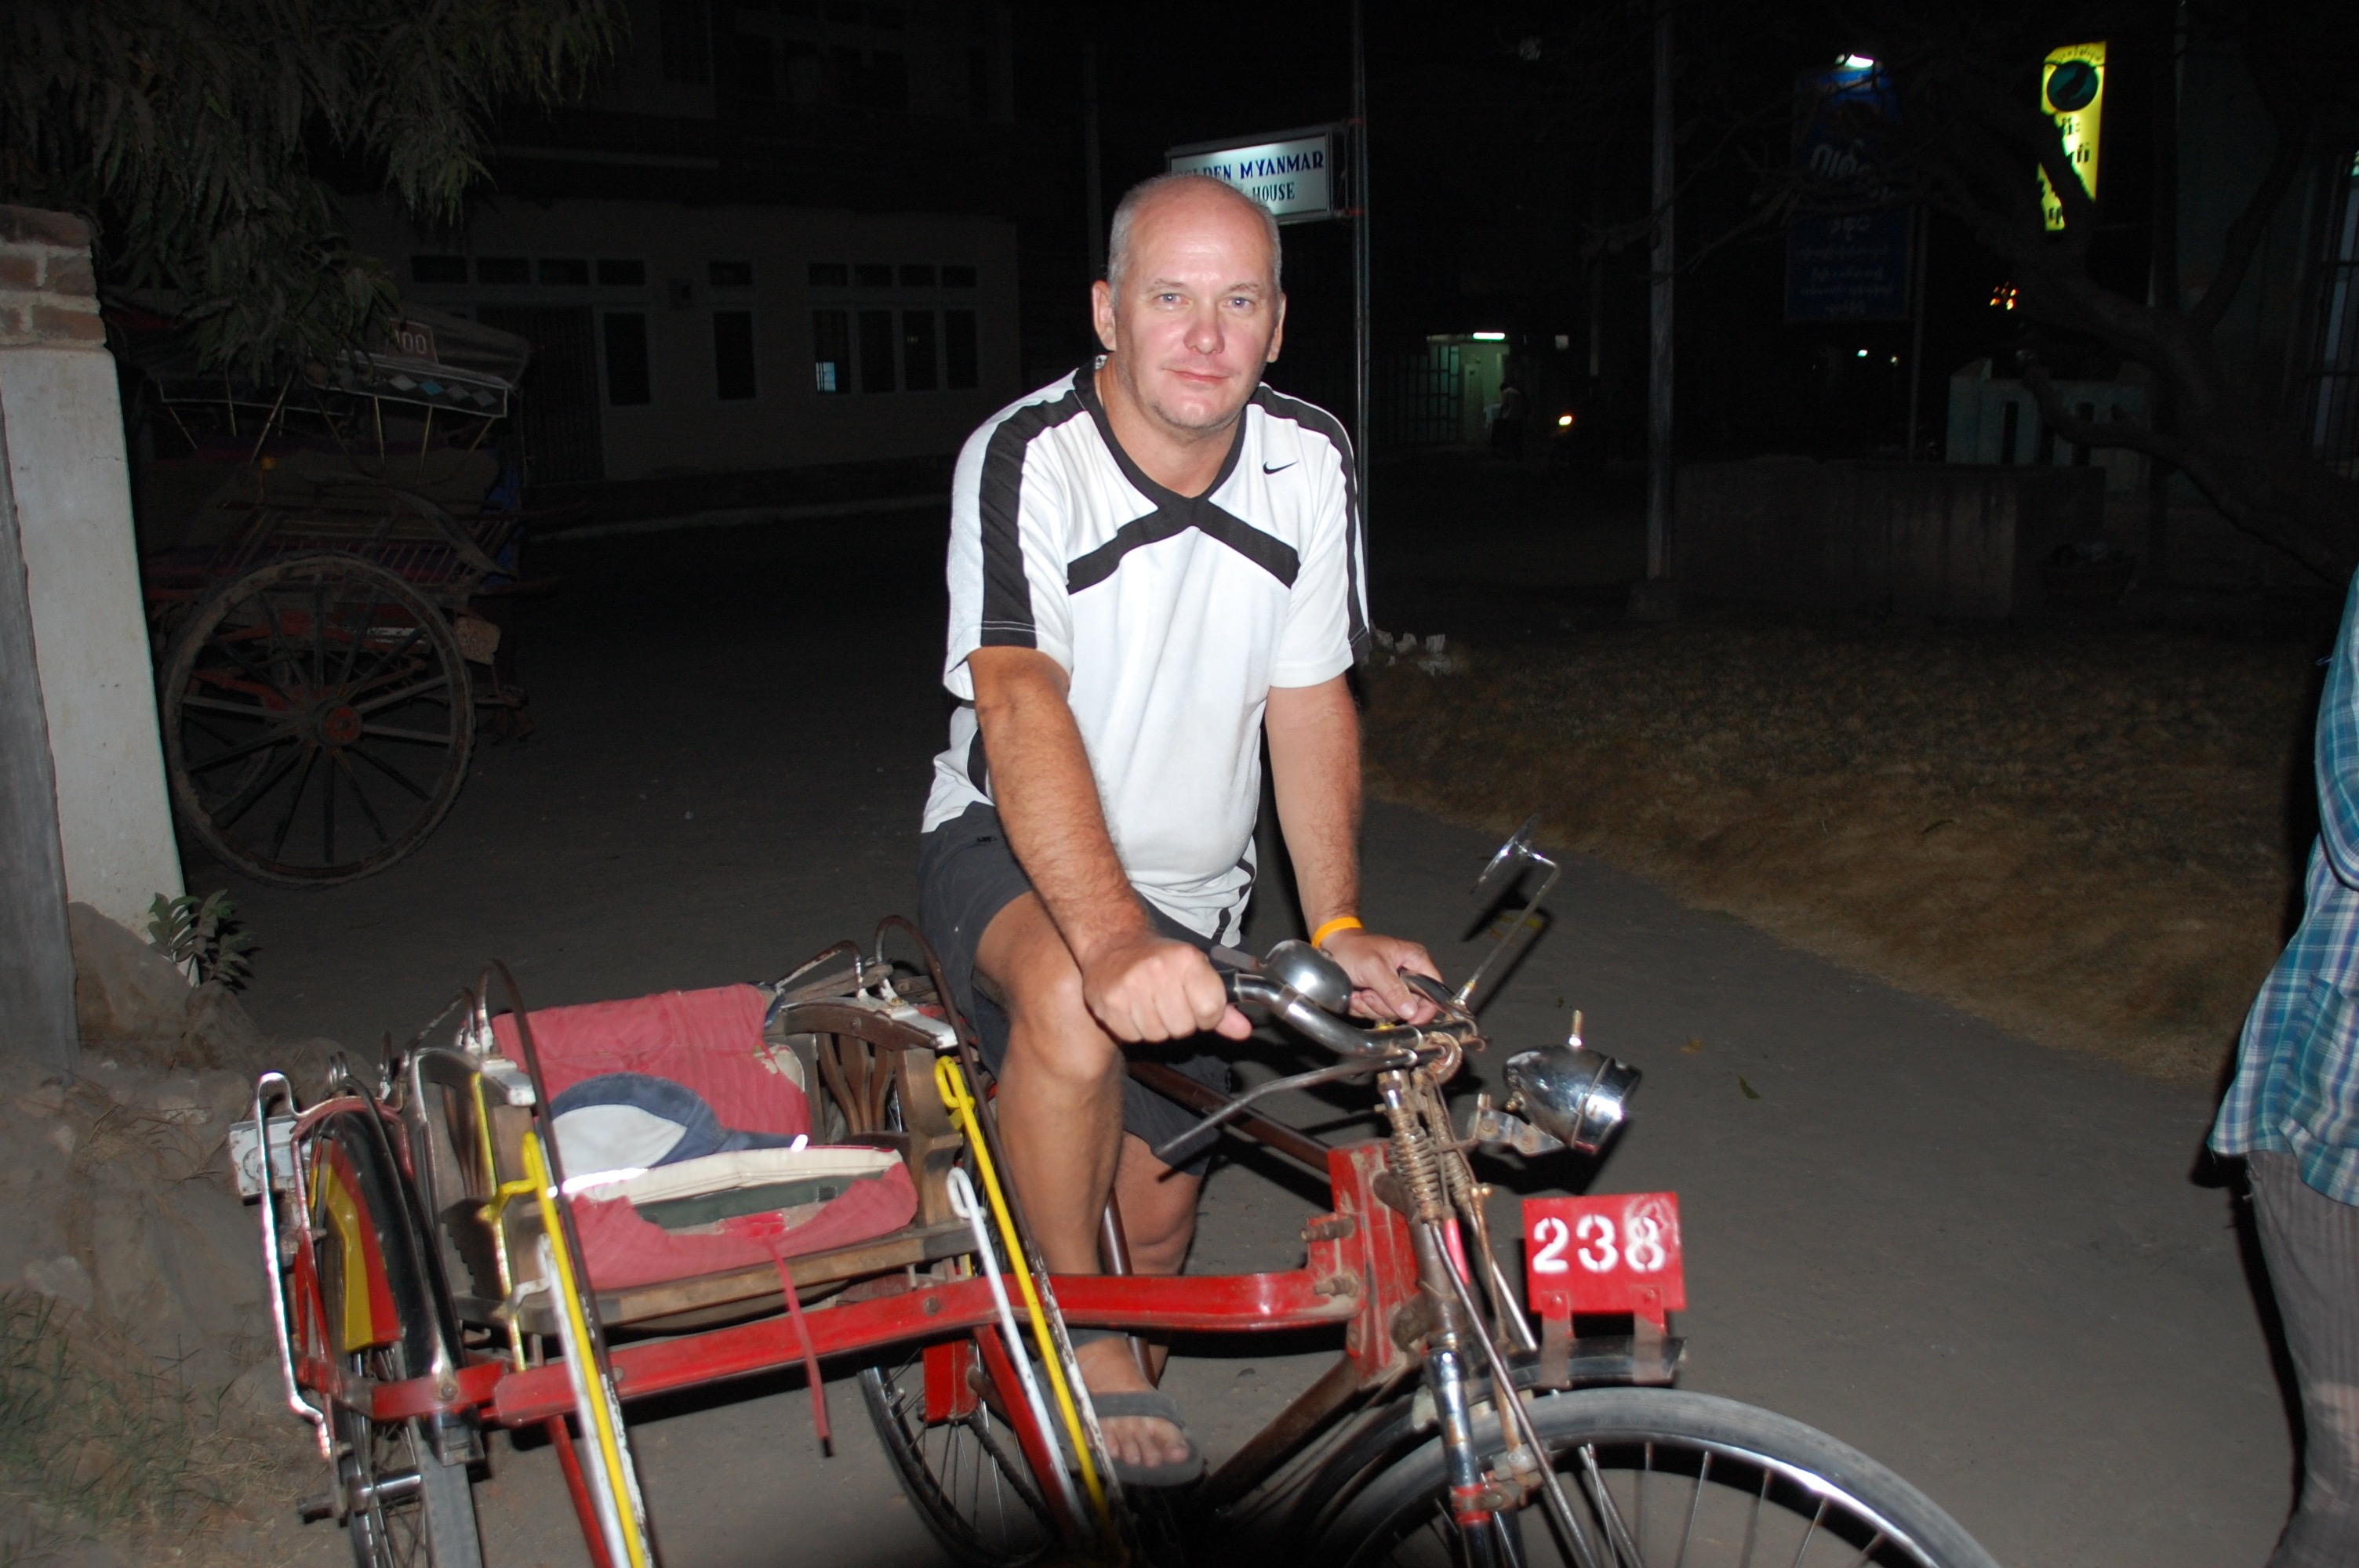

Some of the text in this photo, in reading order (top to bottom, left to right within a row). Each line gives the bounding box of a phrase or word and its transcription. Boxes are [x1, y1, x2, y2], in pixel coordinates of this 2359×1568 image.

[1240, 151, 1324, 179] MYANMAR
[1252, 181, 1295, 201] HOUSE
[1532, 1214, 1666, 1273] 238
